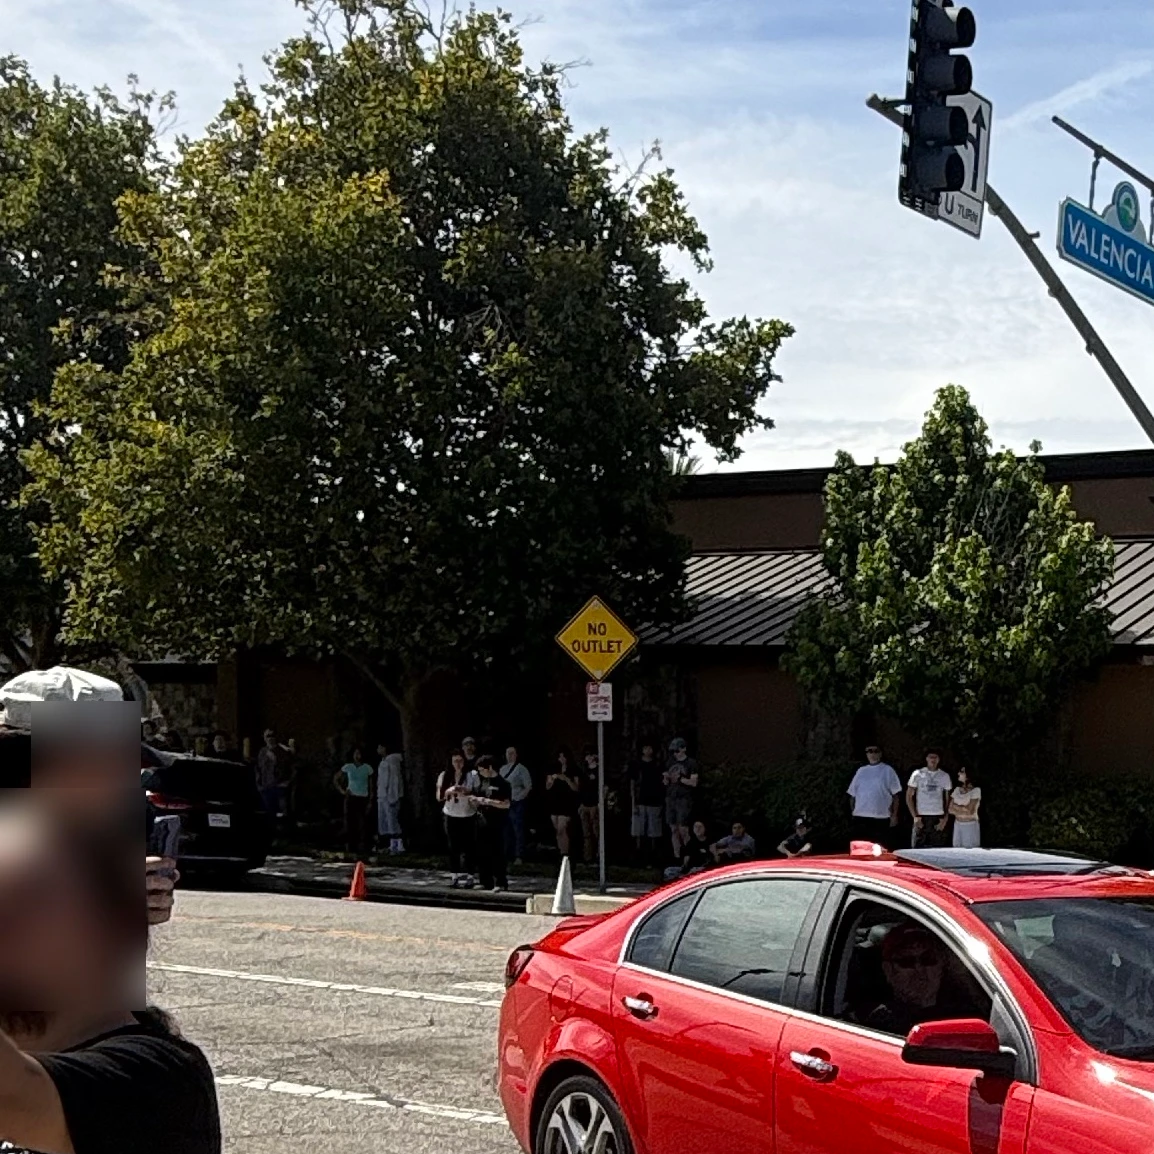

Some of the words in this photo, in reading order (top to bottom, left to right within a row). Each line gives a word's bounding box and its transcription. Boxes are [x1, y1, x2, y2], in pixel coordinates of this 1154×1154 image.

[957, 203, 979, 225] TURN
[1068, 213, 1154, 289] VALENCIA
[587, 622, 607, 636] NO
[572, 639, 622, 653] OUTLET
